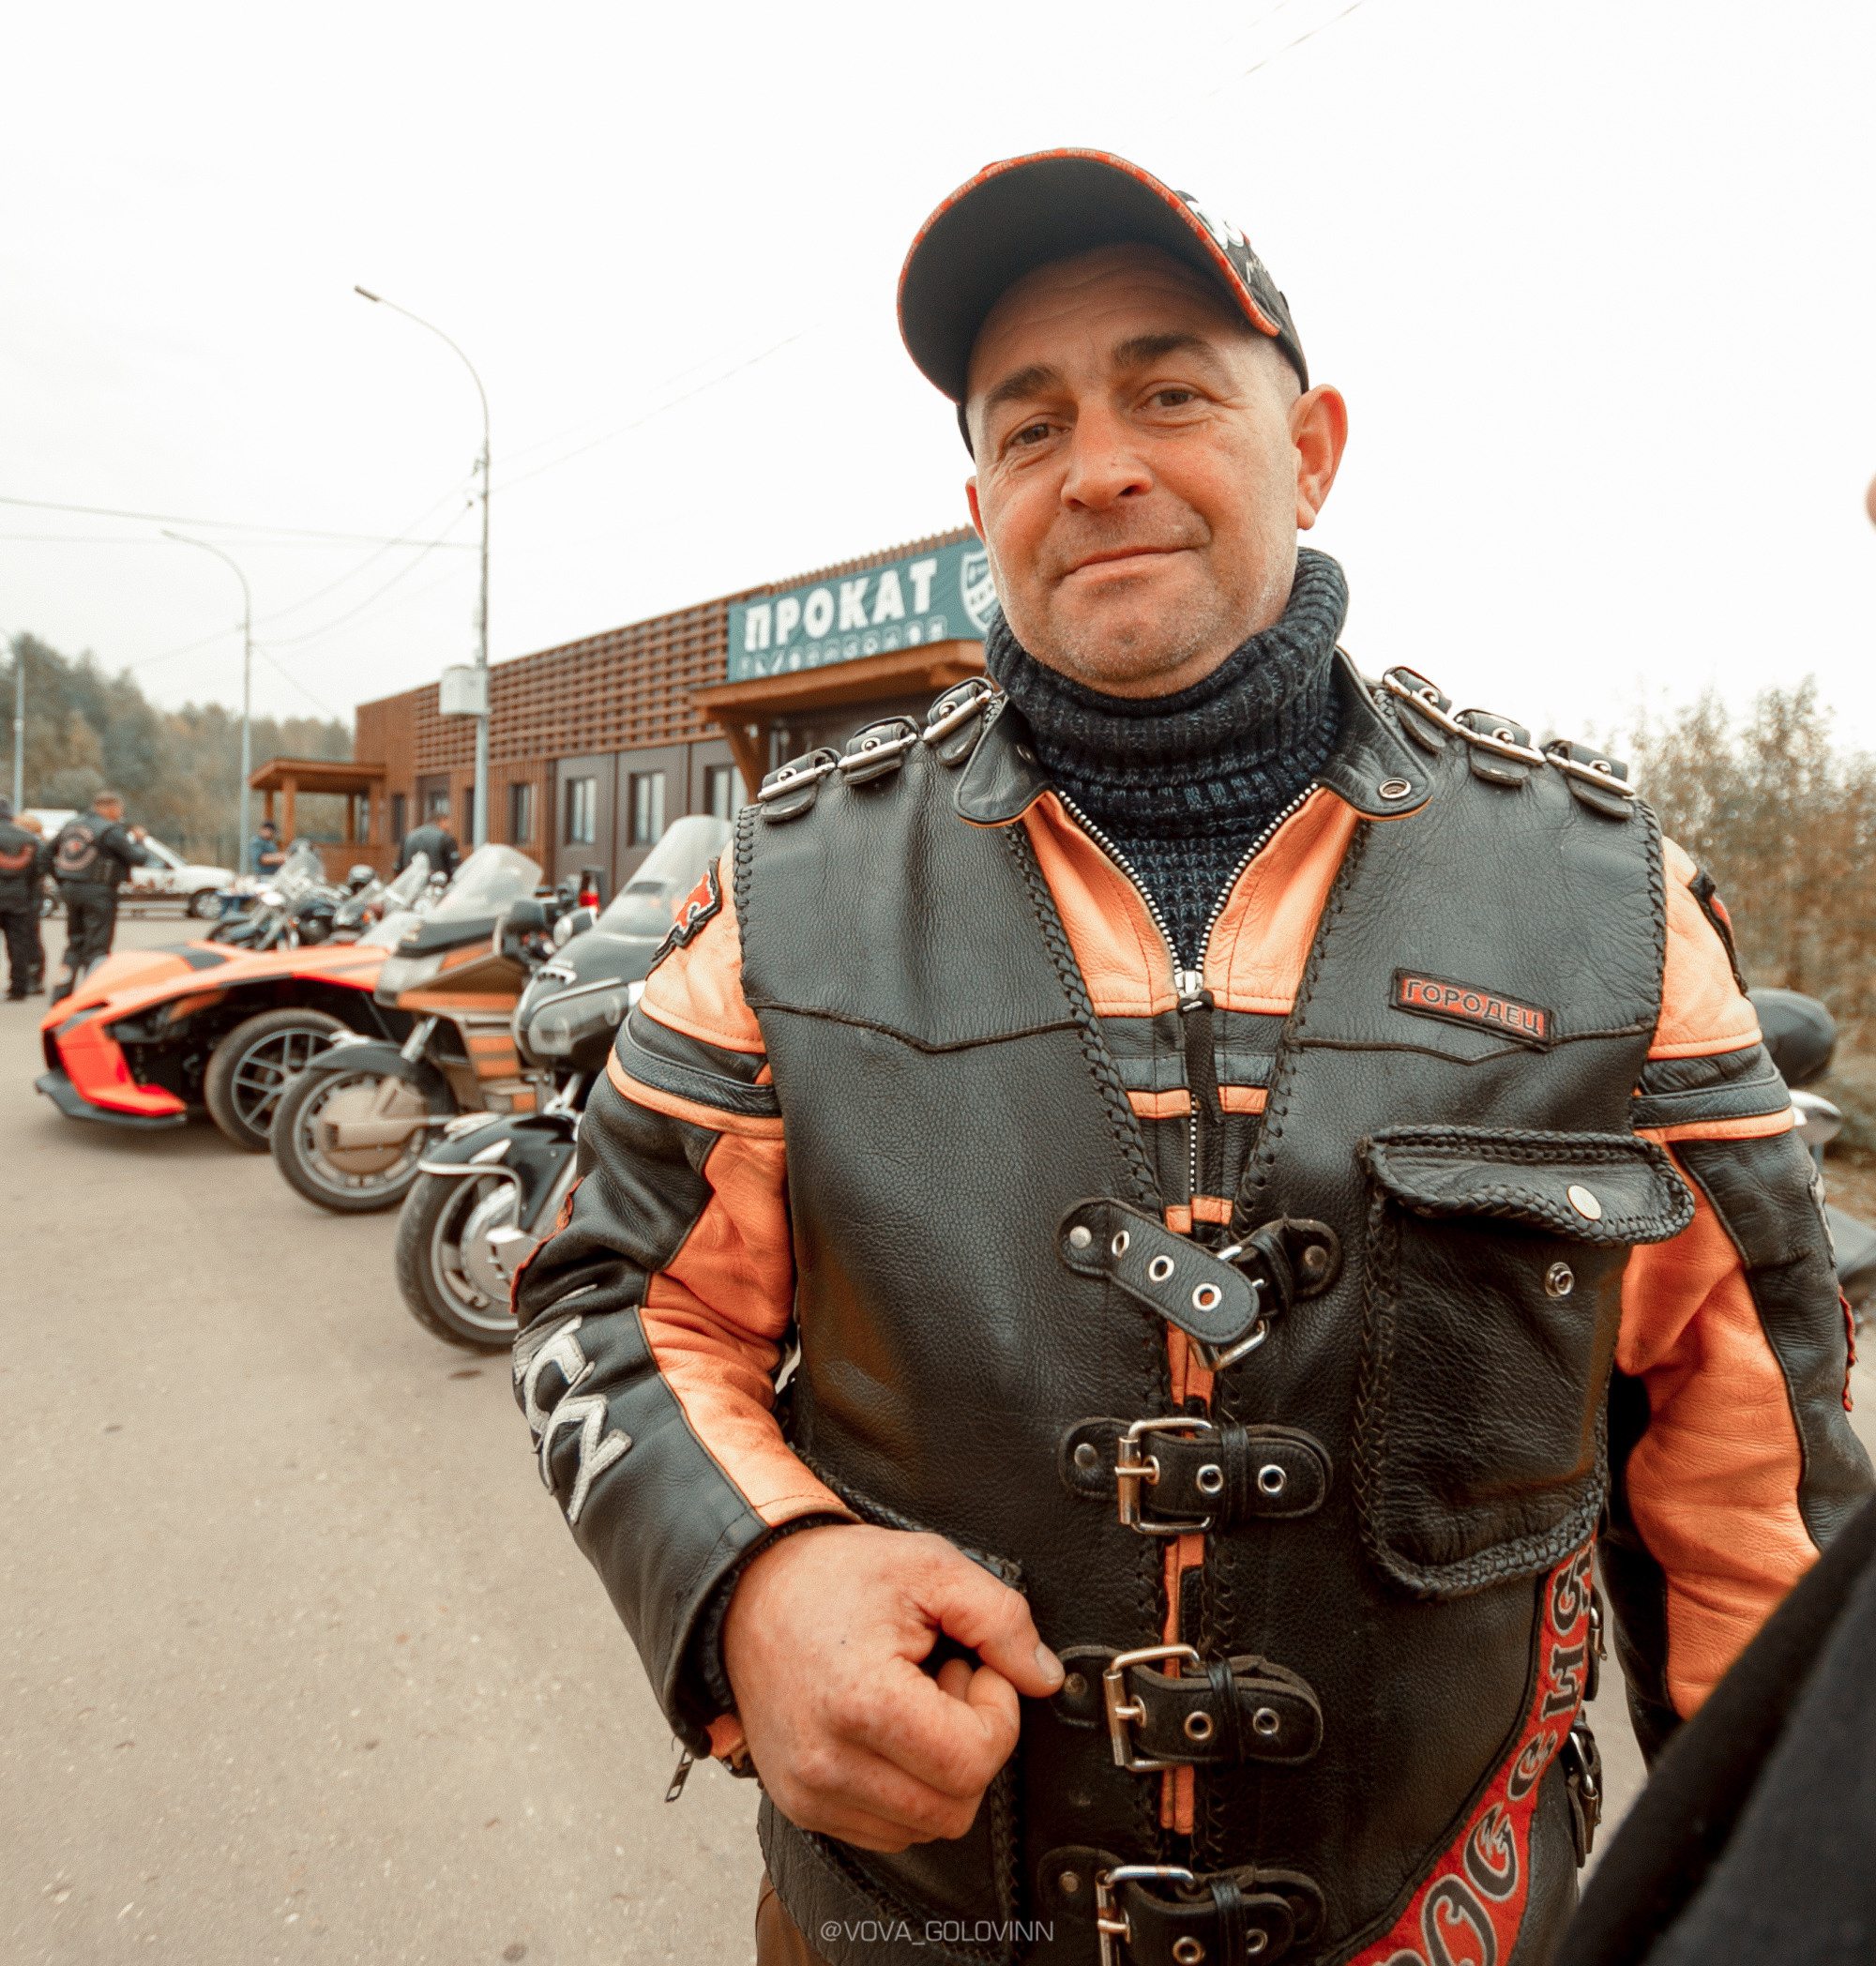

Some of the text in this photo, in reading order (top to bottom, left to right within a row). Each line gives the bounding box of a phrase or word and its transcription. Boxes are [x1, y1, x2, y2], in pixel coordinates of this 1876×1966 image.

[744, 558, 937, 652] ПРОКАТ
[1406, 979, 1540, 1036] ГОРОДЕЦ
[1371, 1540, 1594, 1966] ОССИЯ
